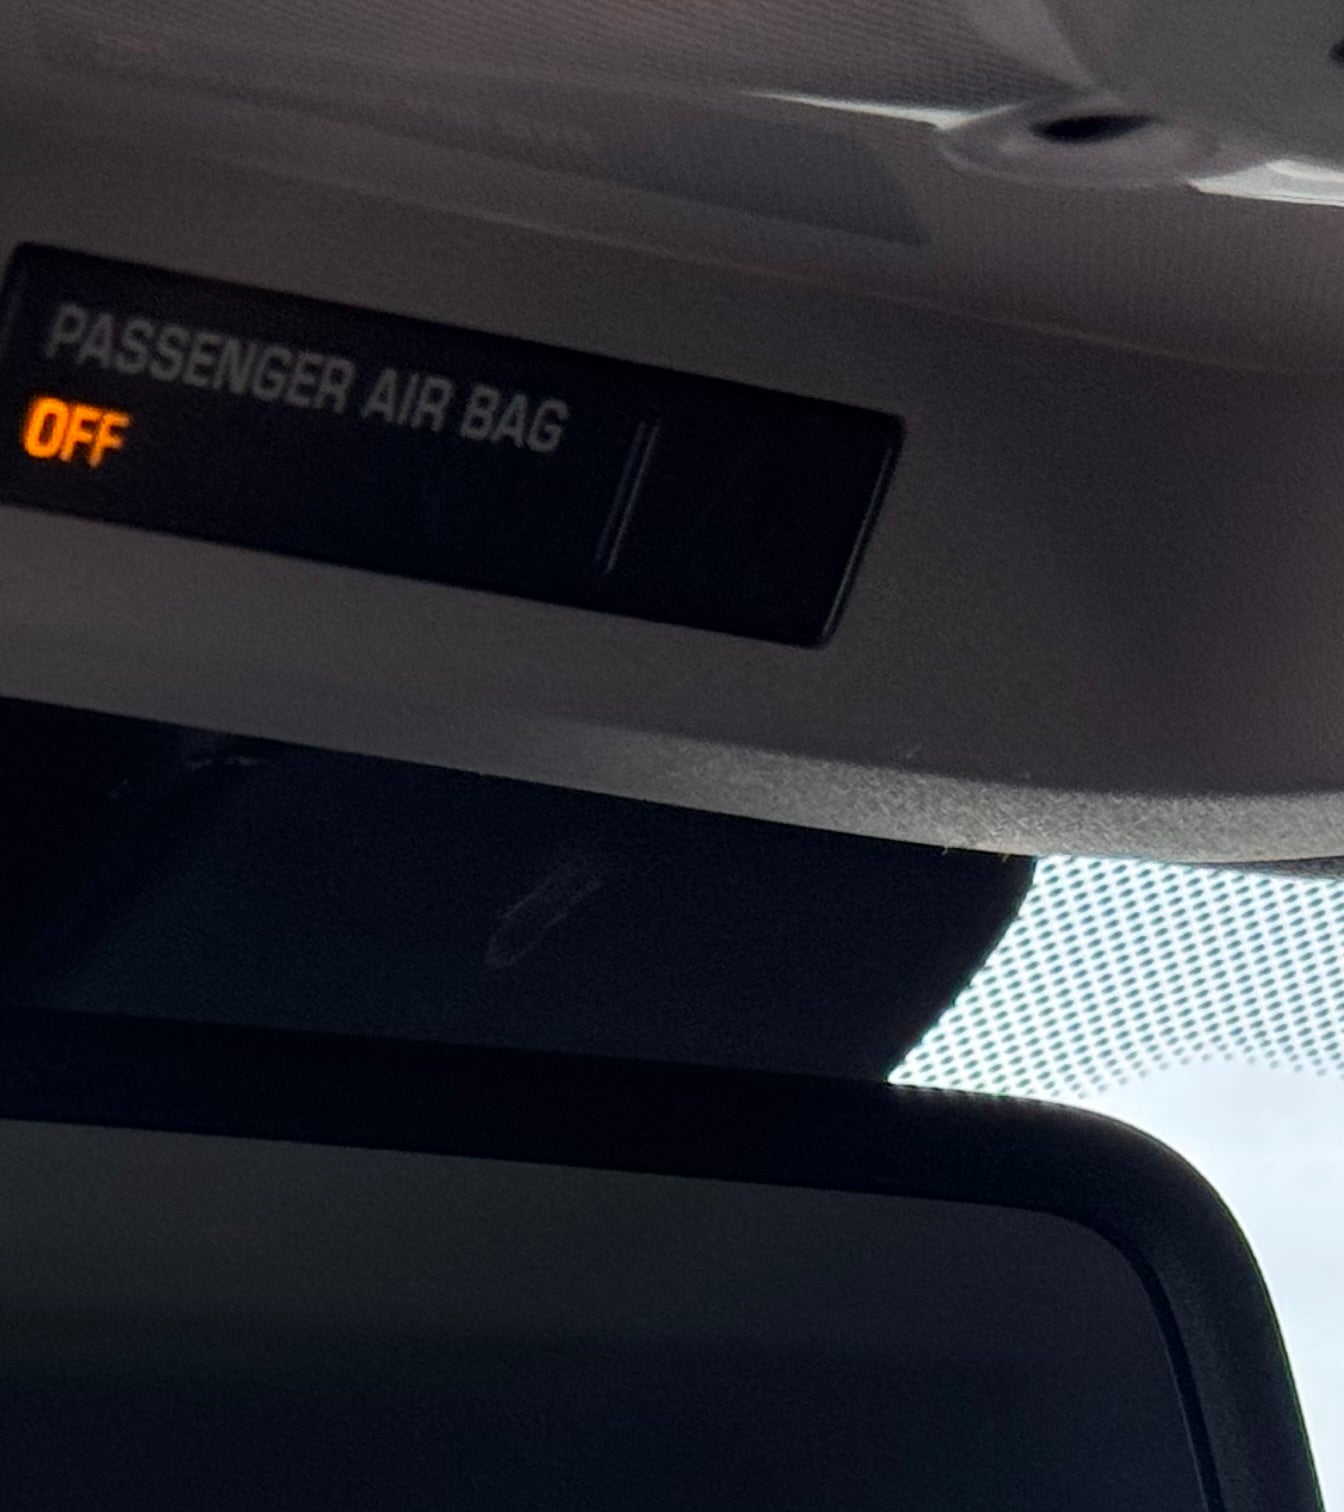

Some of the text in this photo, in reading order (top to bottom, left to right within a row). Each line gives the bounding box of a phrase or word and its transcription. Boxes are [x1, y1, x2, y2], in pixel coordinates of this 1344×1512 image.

[21, 396, 130, 467] OFF
[44, 304, 568, 452] PASSENGER AIR BAG
